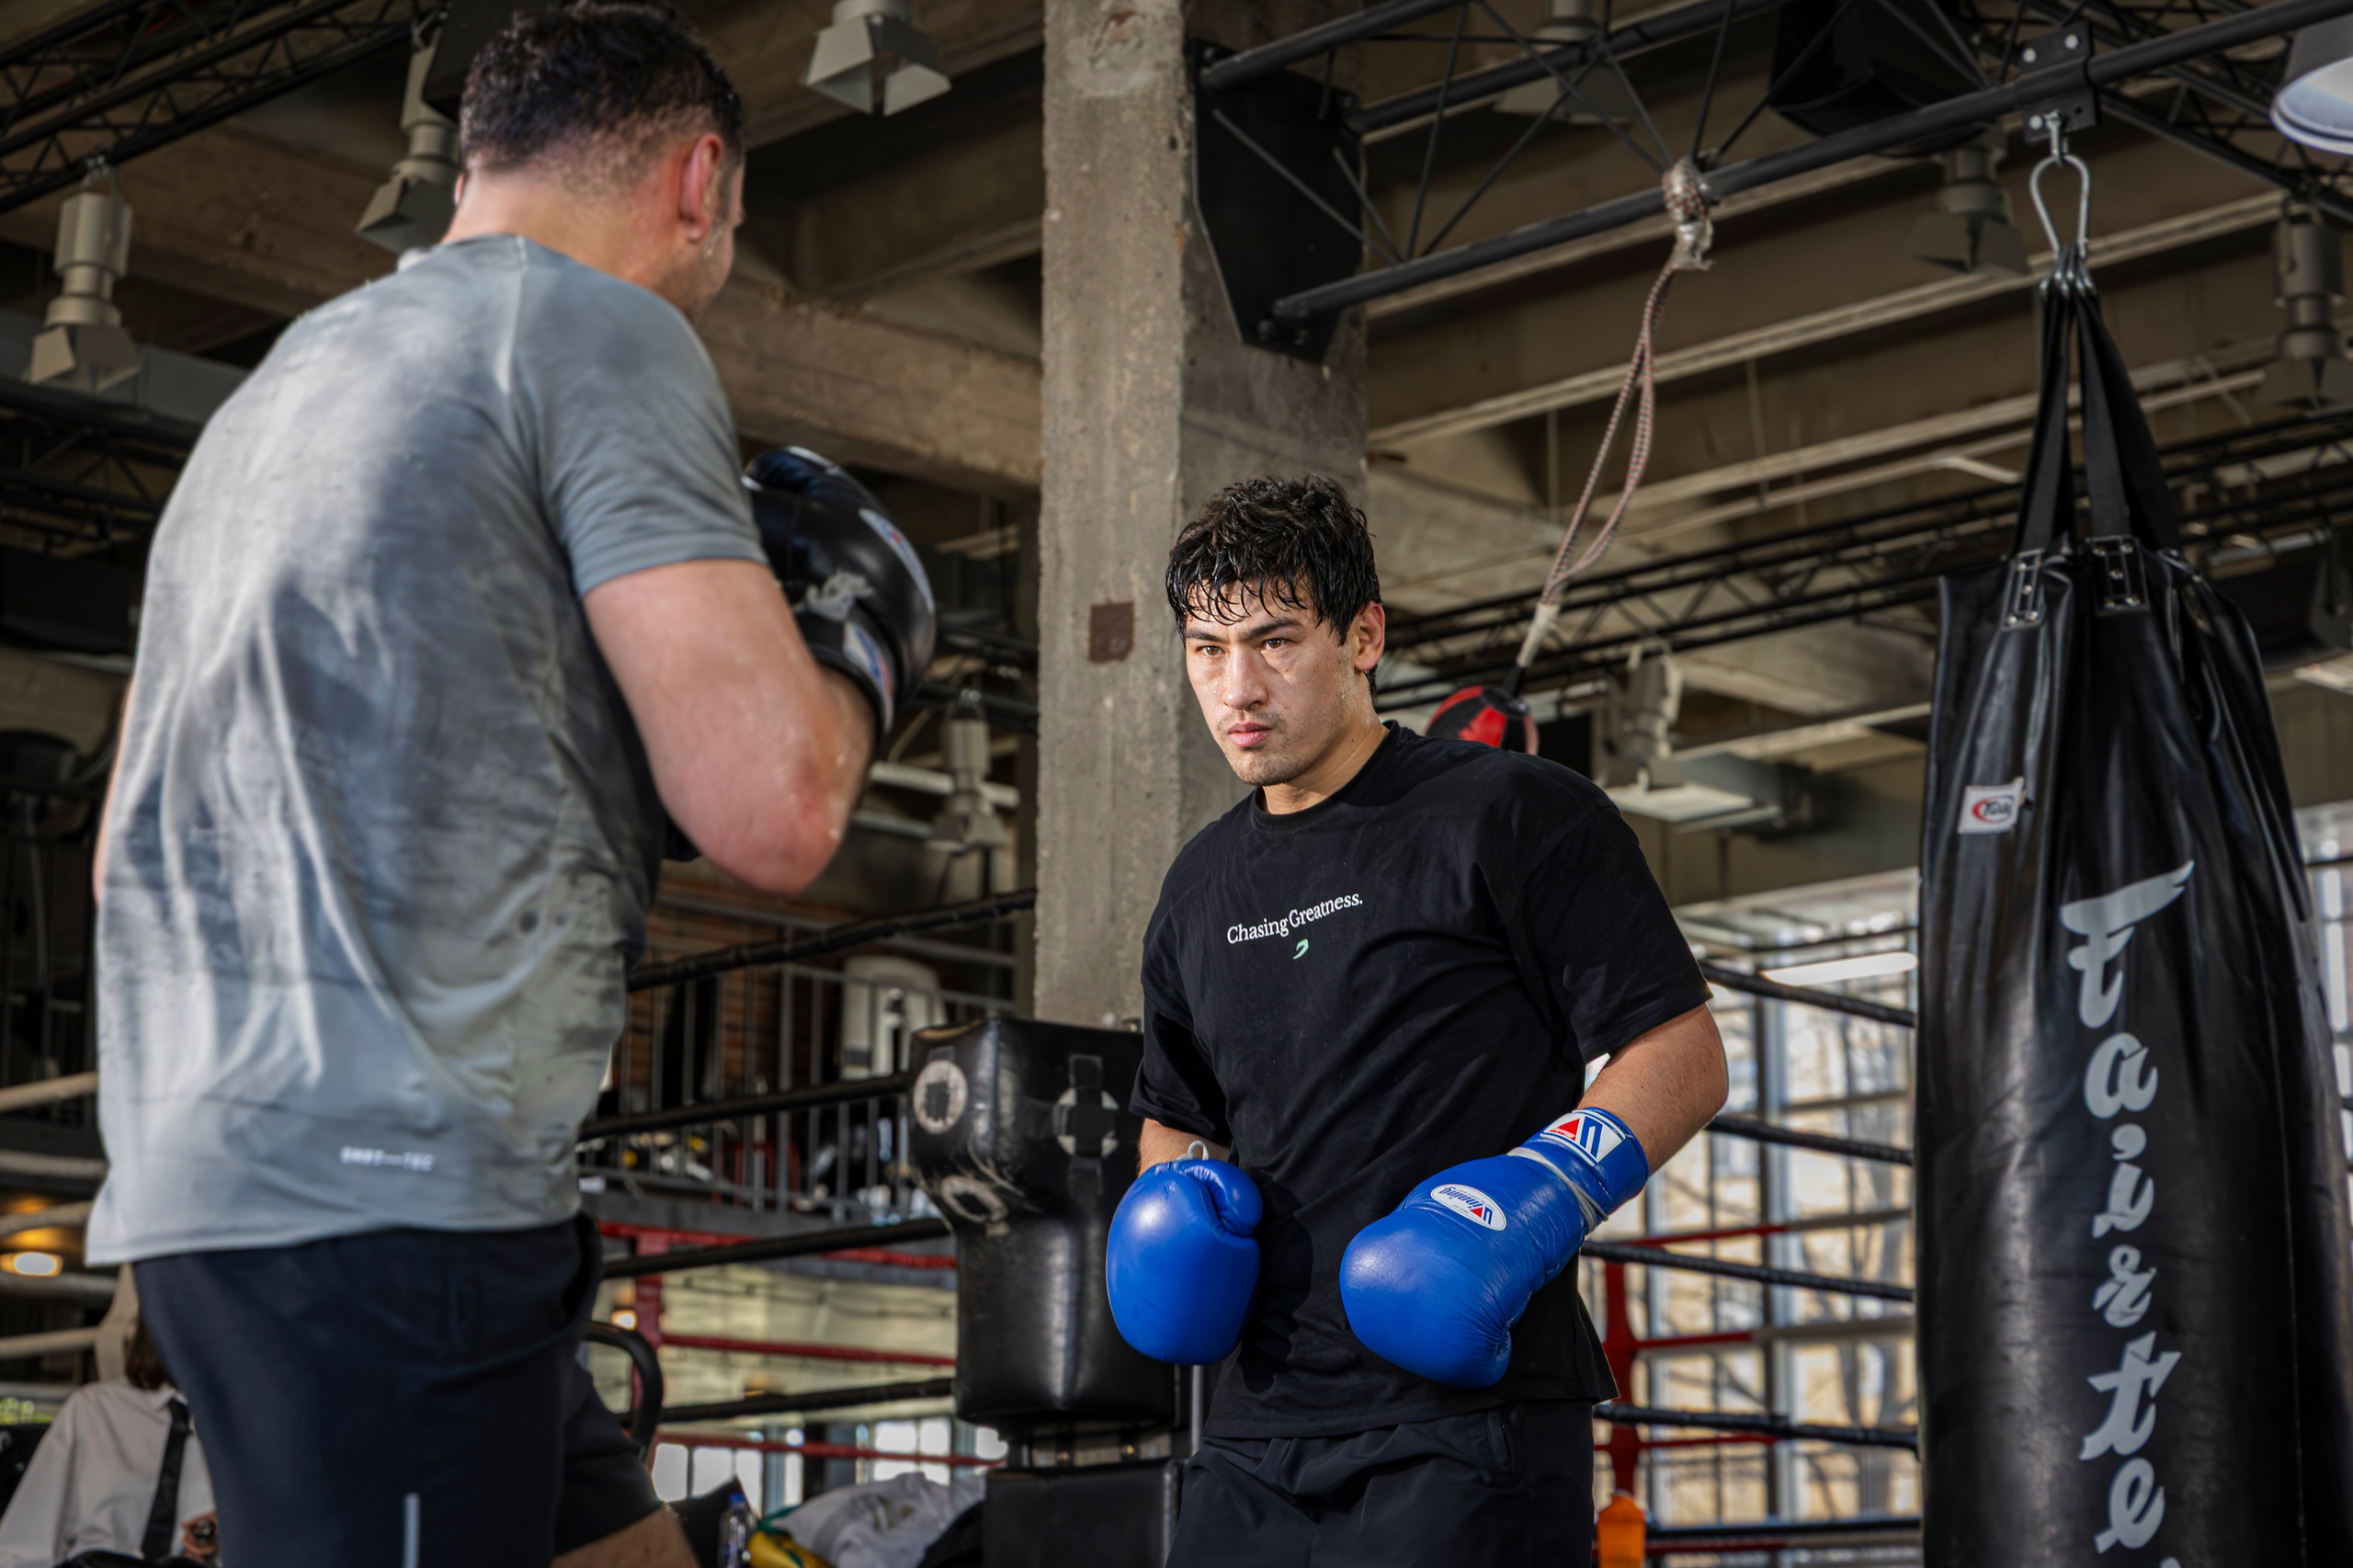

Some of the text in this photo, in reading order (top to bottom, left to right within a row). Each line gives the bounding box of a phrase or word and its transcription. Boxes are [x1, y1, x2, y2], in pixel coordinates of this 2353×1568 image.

[1227, 892, 1363, 944] Chasing Greatness.
[1438, 1187, 1494, 1225] Winning
[2059, 860, 2195, 1568] Fairte
